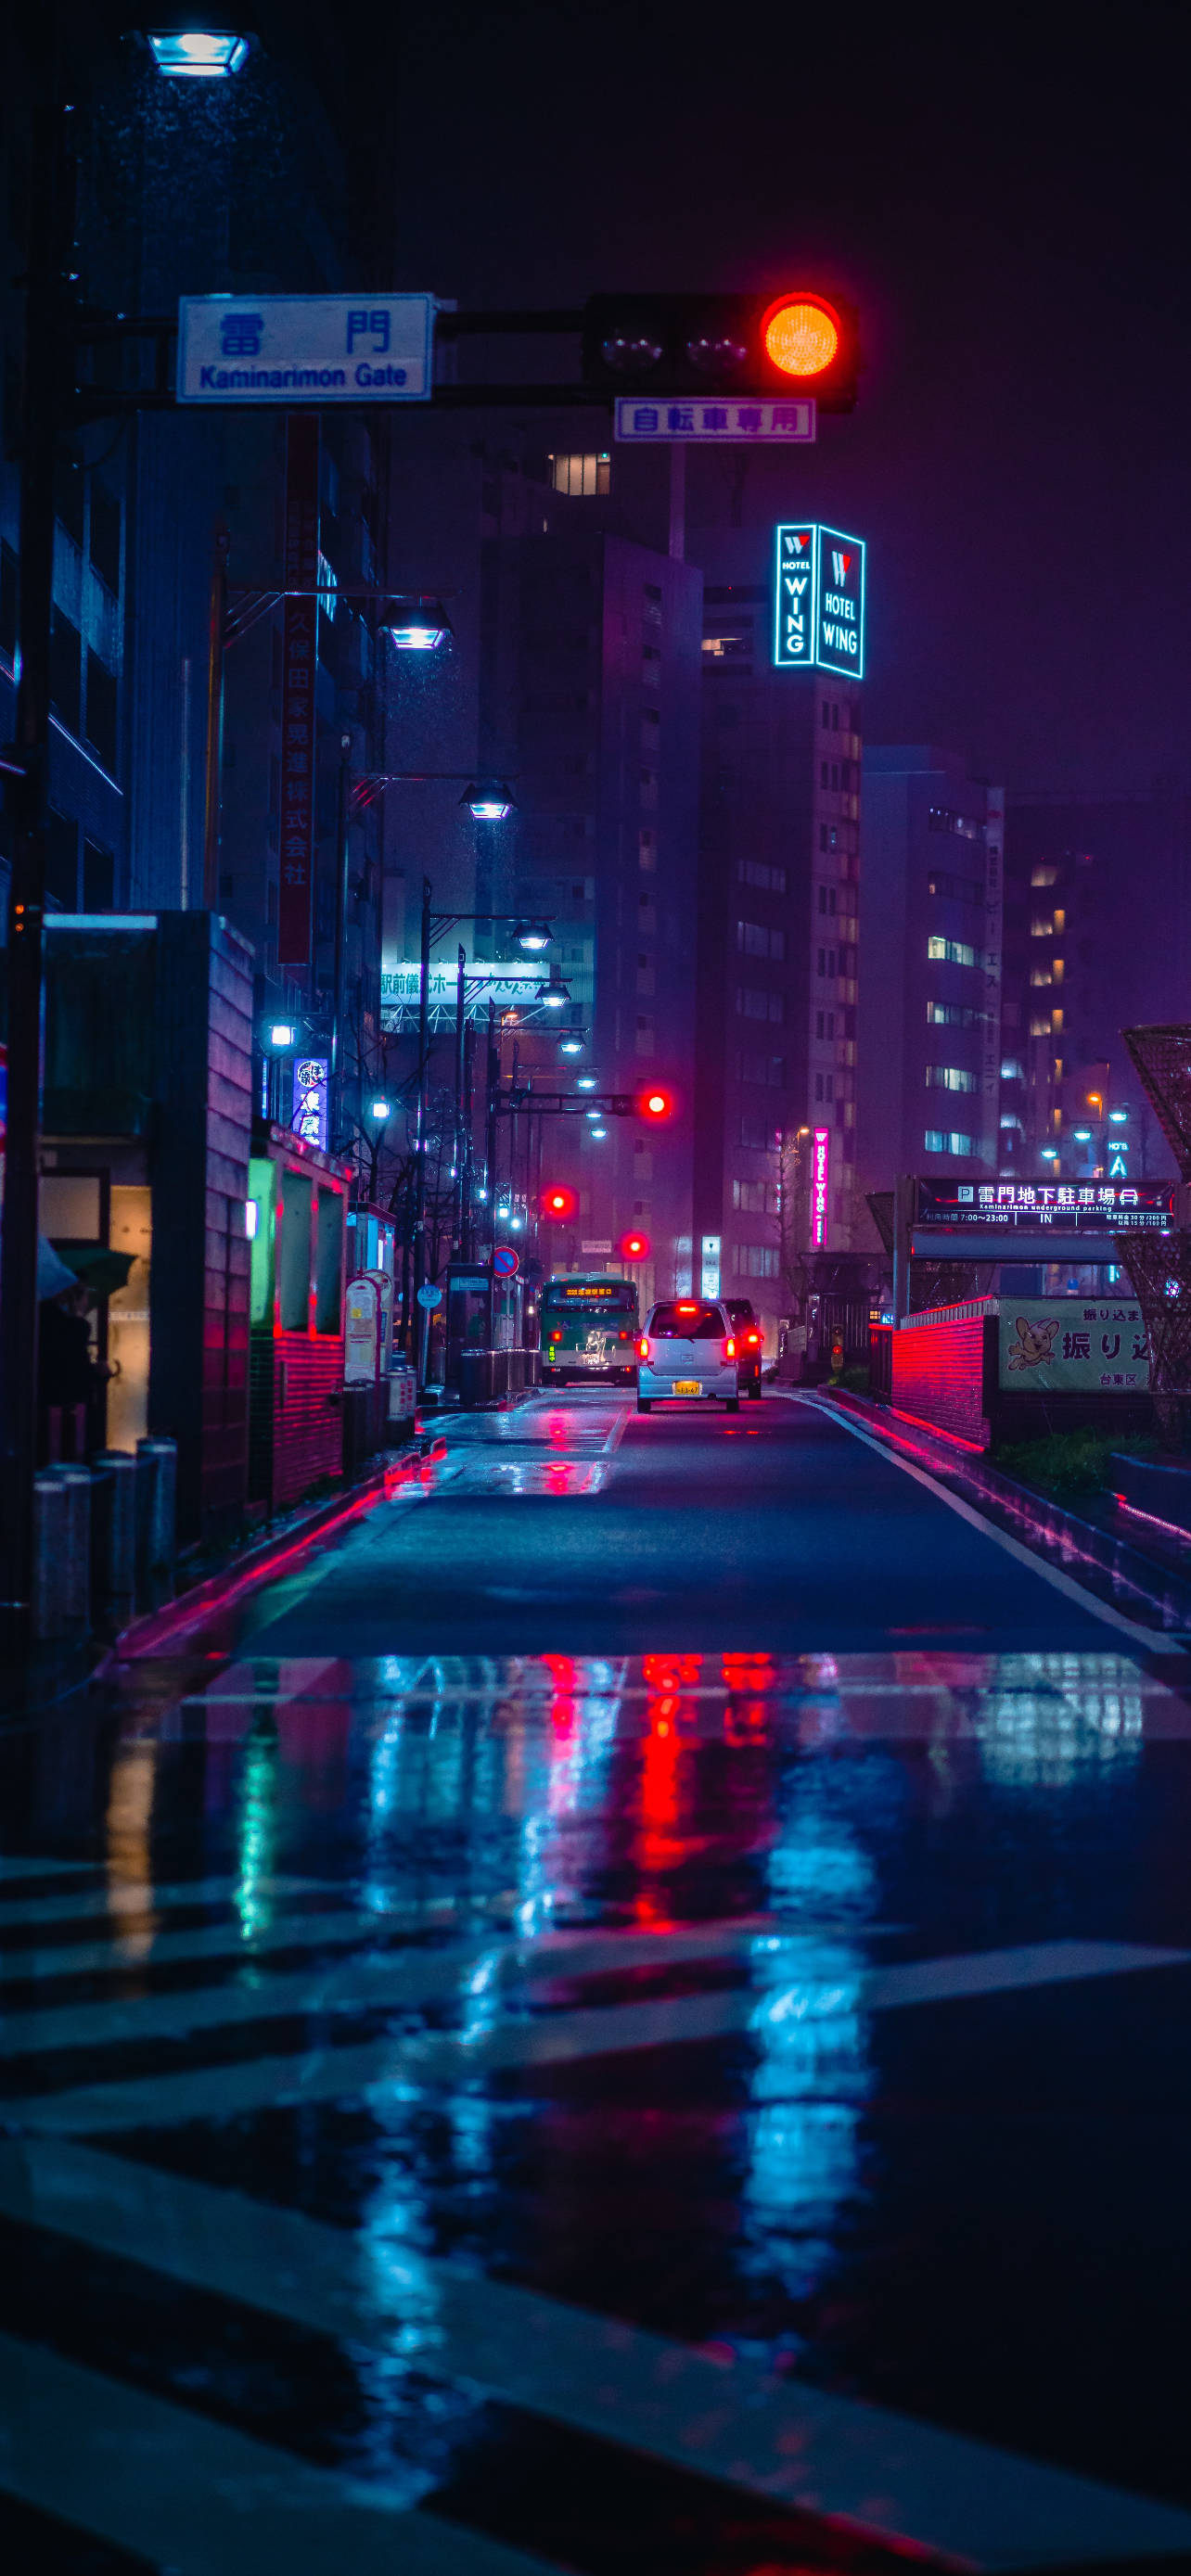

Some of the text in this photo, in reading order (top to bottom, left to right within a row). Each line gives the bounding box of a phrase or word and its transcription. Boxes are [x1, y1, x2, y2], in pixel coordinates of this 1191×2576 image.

[220, 310, 391, 356] 雷門
[199, 363, 407, 389] Kaminarimon Gate
[634, 407, 799, 432] 自転車専用
[782, 561, 811, 570] HOTEL
[784, 577, 808, 653] WING
[825, 592, 855, 621] HOTEL
[822, 620, 858, 655] WING
[978, 1186, 1115, 1205] 雷門地下駐車場
[1031, 1204, 1081, 1212] underground
[1040, 1213, 1052, 1223] IN
[1083, 1308, 1144, 1321] 振り込ま
[1100, 1373, 1137, 1385] 台東区
